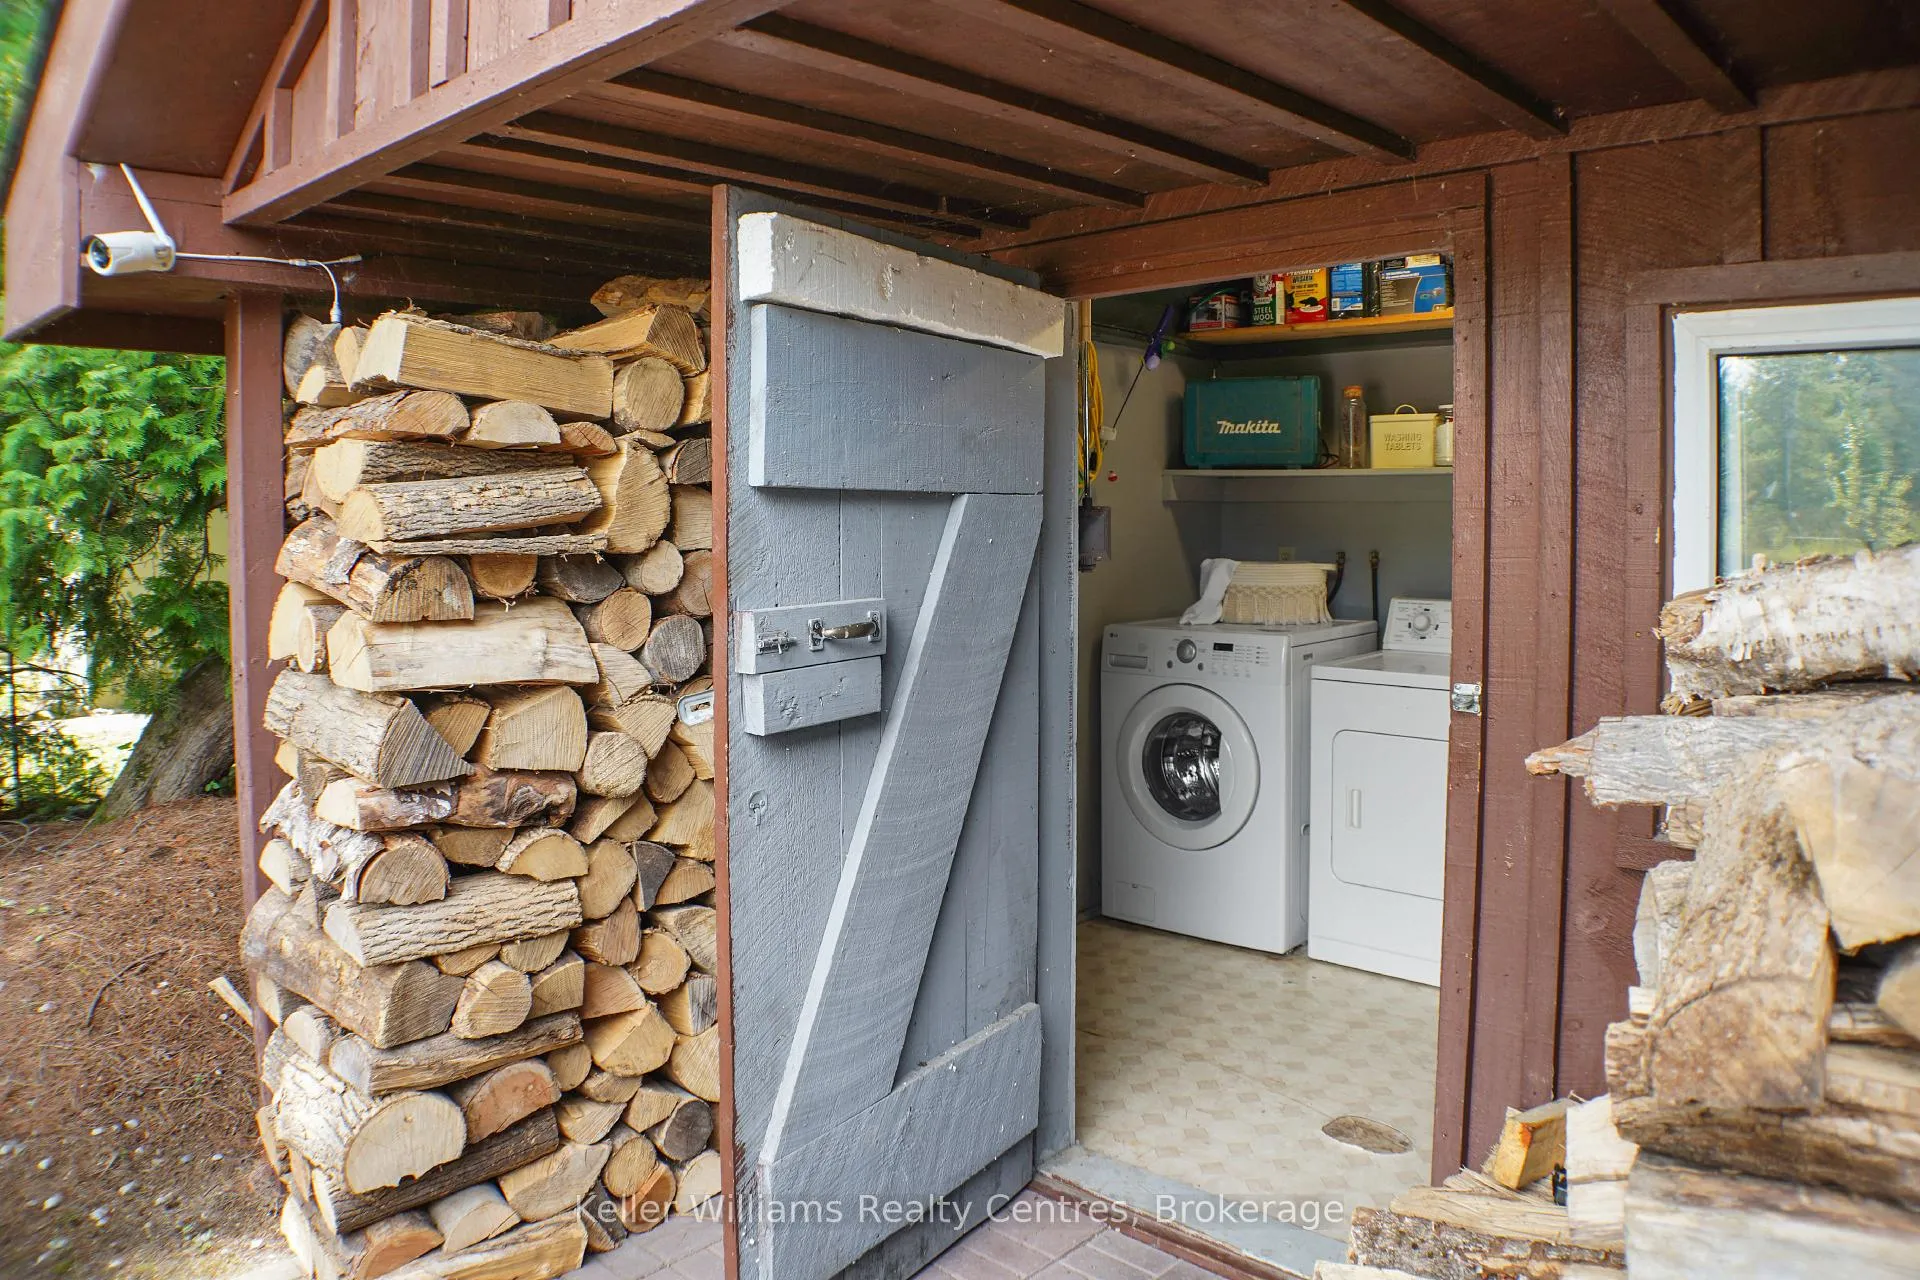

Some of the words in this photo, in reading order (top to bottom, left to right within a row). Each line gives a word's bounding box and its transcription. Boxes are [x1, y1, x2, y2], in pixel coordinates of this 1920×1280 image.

[1254, 306, 1272, 315] STEEL
[1253, 313, 1274, 321] WOOL
[1384, 432, 1423, 442] WASHING
[1384, 442, 1423, 451] TABLETS
